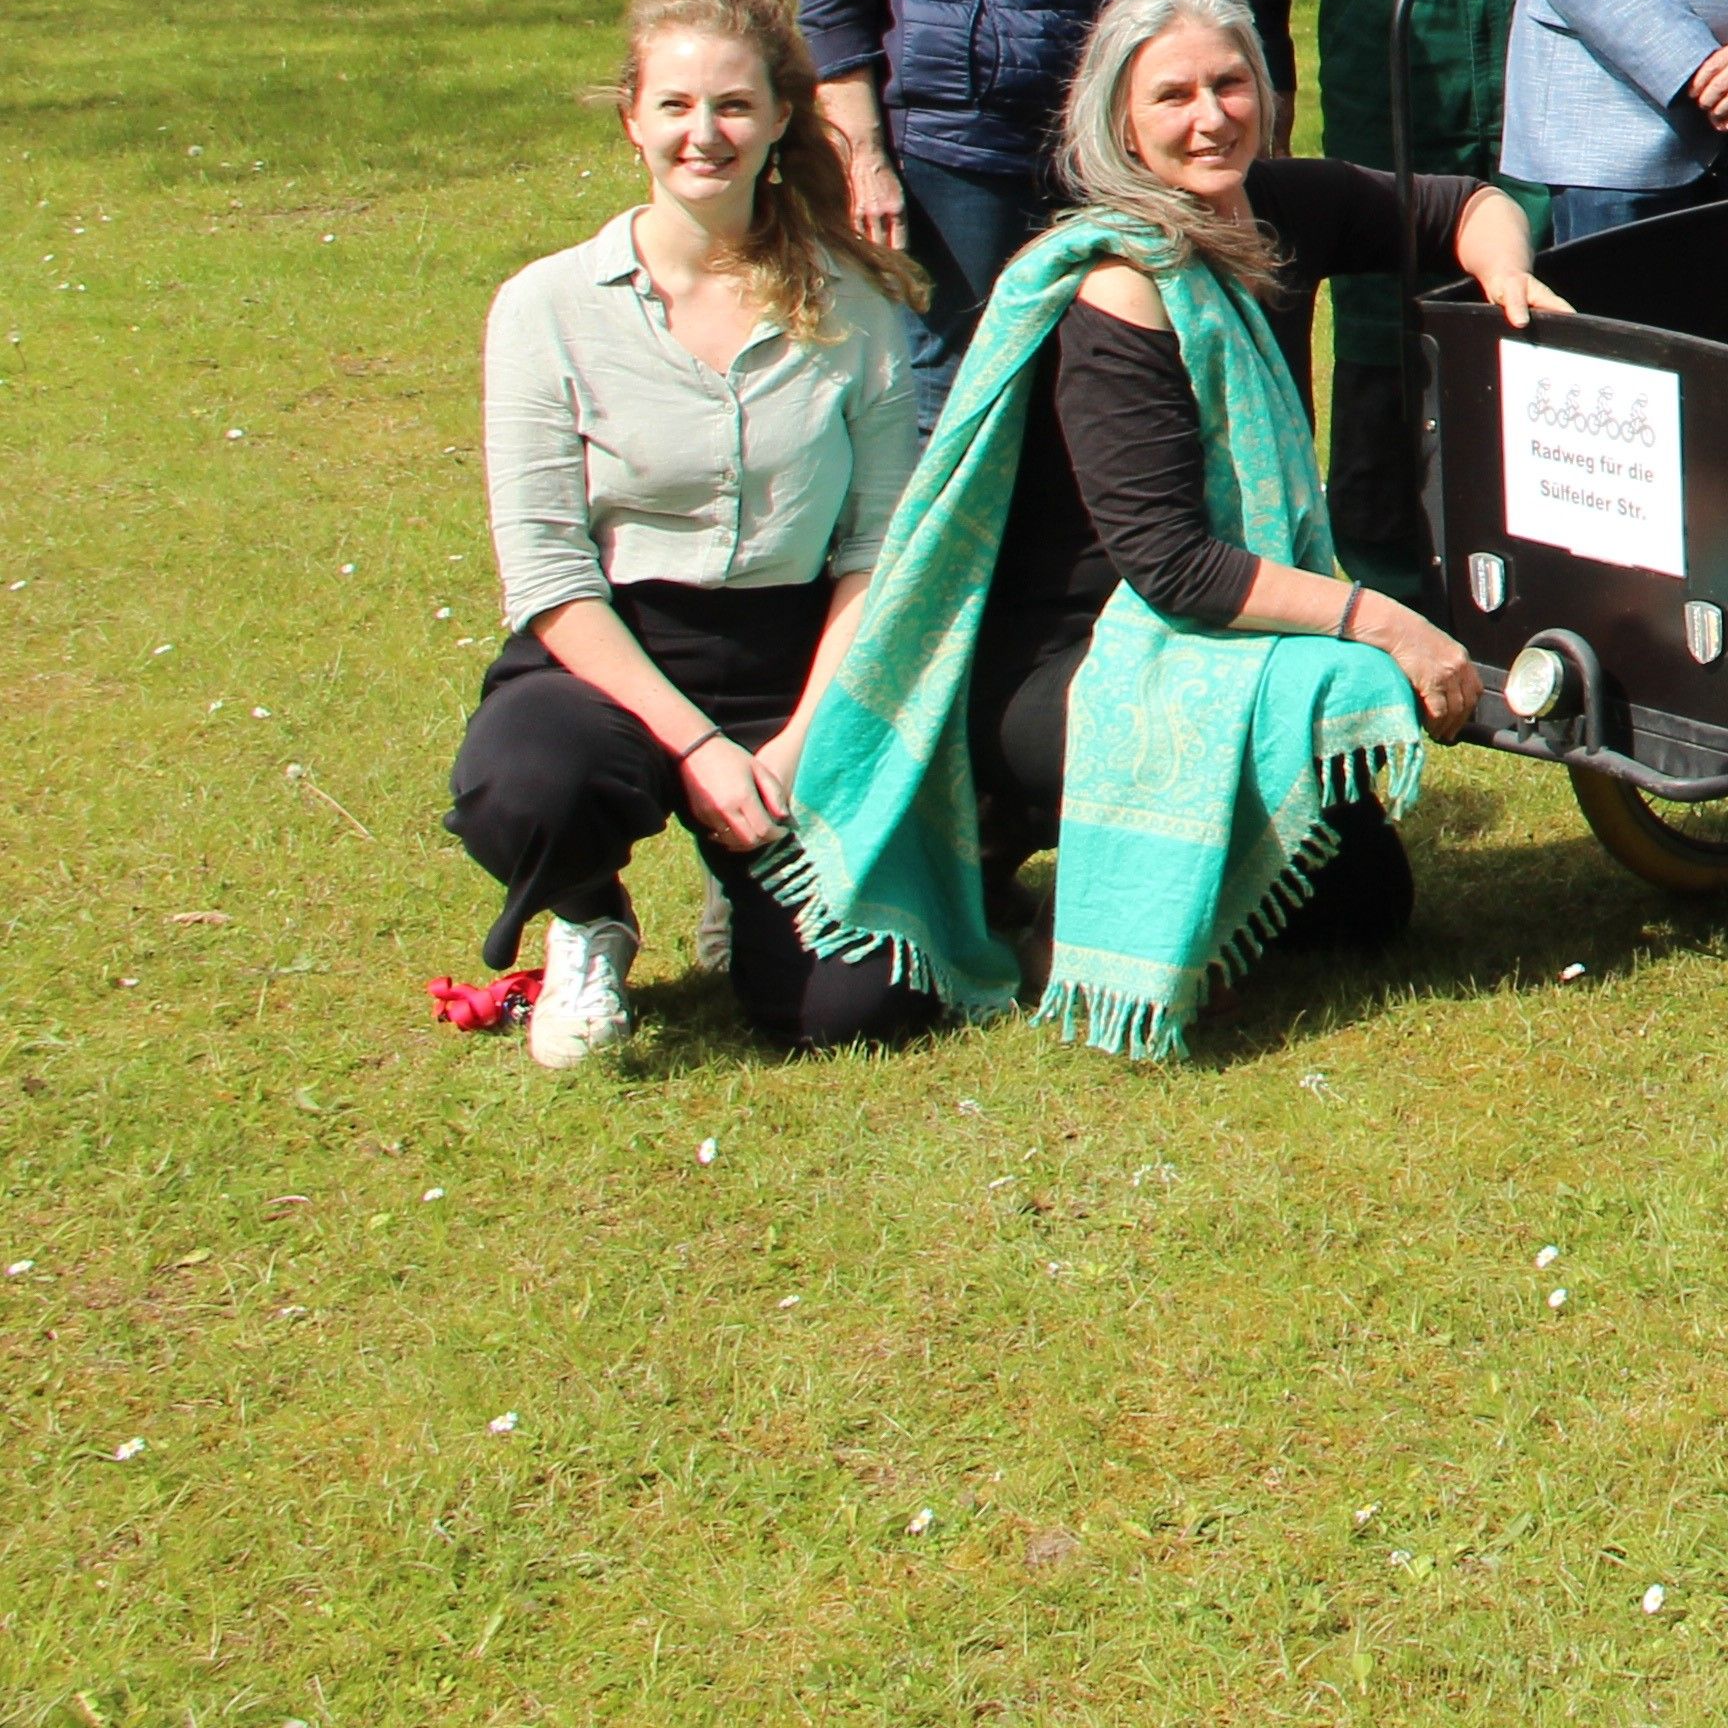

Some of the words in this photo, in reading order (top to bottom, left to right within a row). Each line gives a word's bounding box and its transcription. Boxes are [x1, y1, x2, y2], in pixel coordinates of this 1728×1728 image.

[1531, 439, 1595, 474] Radweg
[1599, 455, 1623, 476] für
[1628, 462, 1654, 483] die
[1540, 479, 1612, 512] Sülfelder
[1617, 497, 1647, 521] Str.
